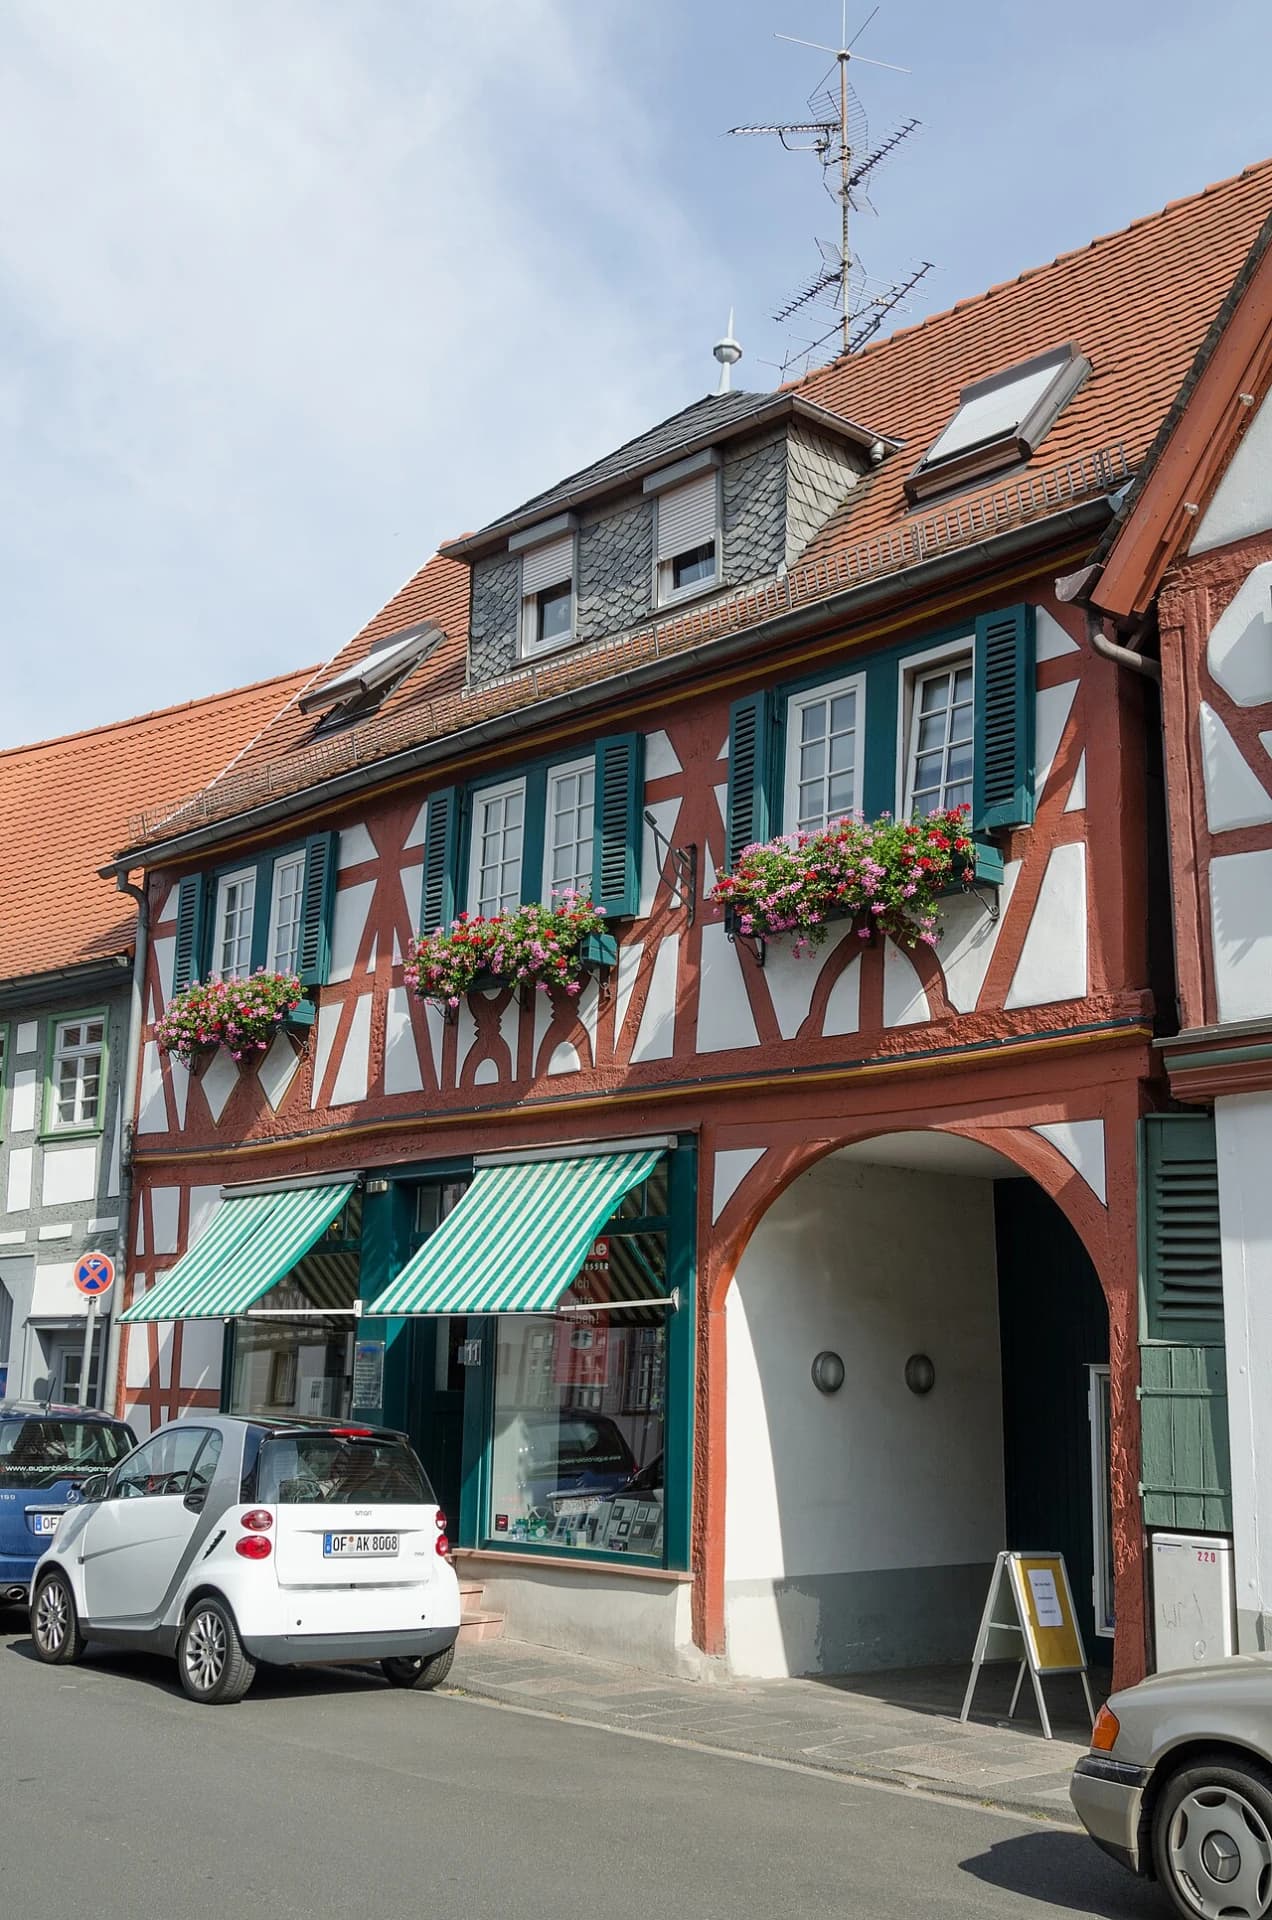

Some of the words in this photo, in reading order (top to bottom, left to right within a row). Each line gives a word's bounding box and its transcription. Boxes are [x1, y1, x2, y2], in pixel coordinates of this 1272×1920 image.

[581, 1262, 609, 1271] ESSER
[574, 1276, 590, 1289] Ich
[564, 1311, 600, 1325] Leben!
[333, 1536, 347, 1551] OF
[356, 1536, 370, 1551] AK
[372, 1535, 398, 1551] 8008
[1198, 1551, 1216, 1563] 220
